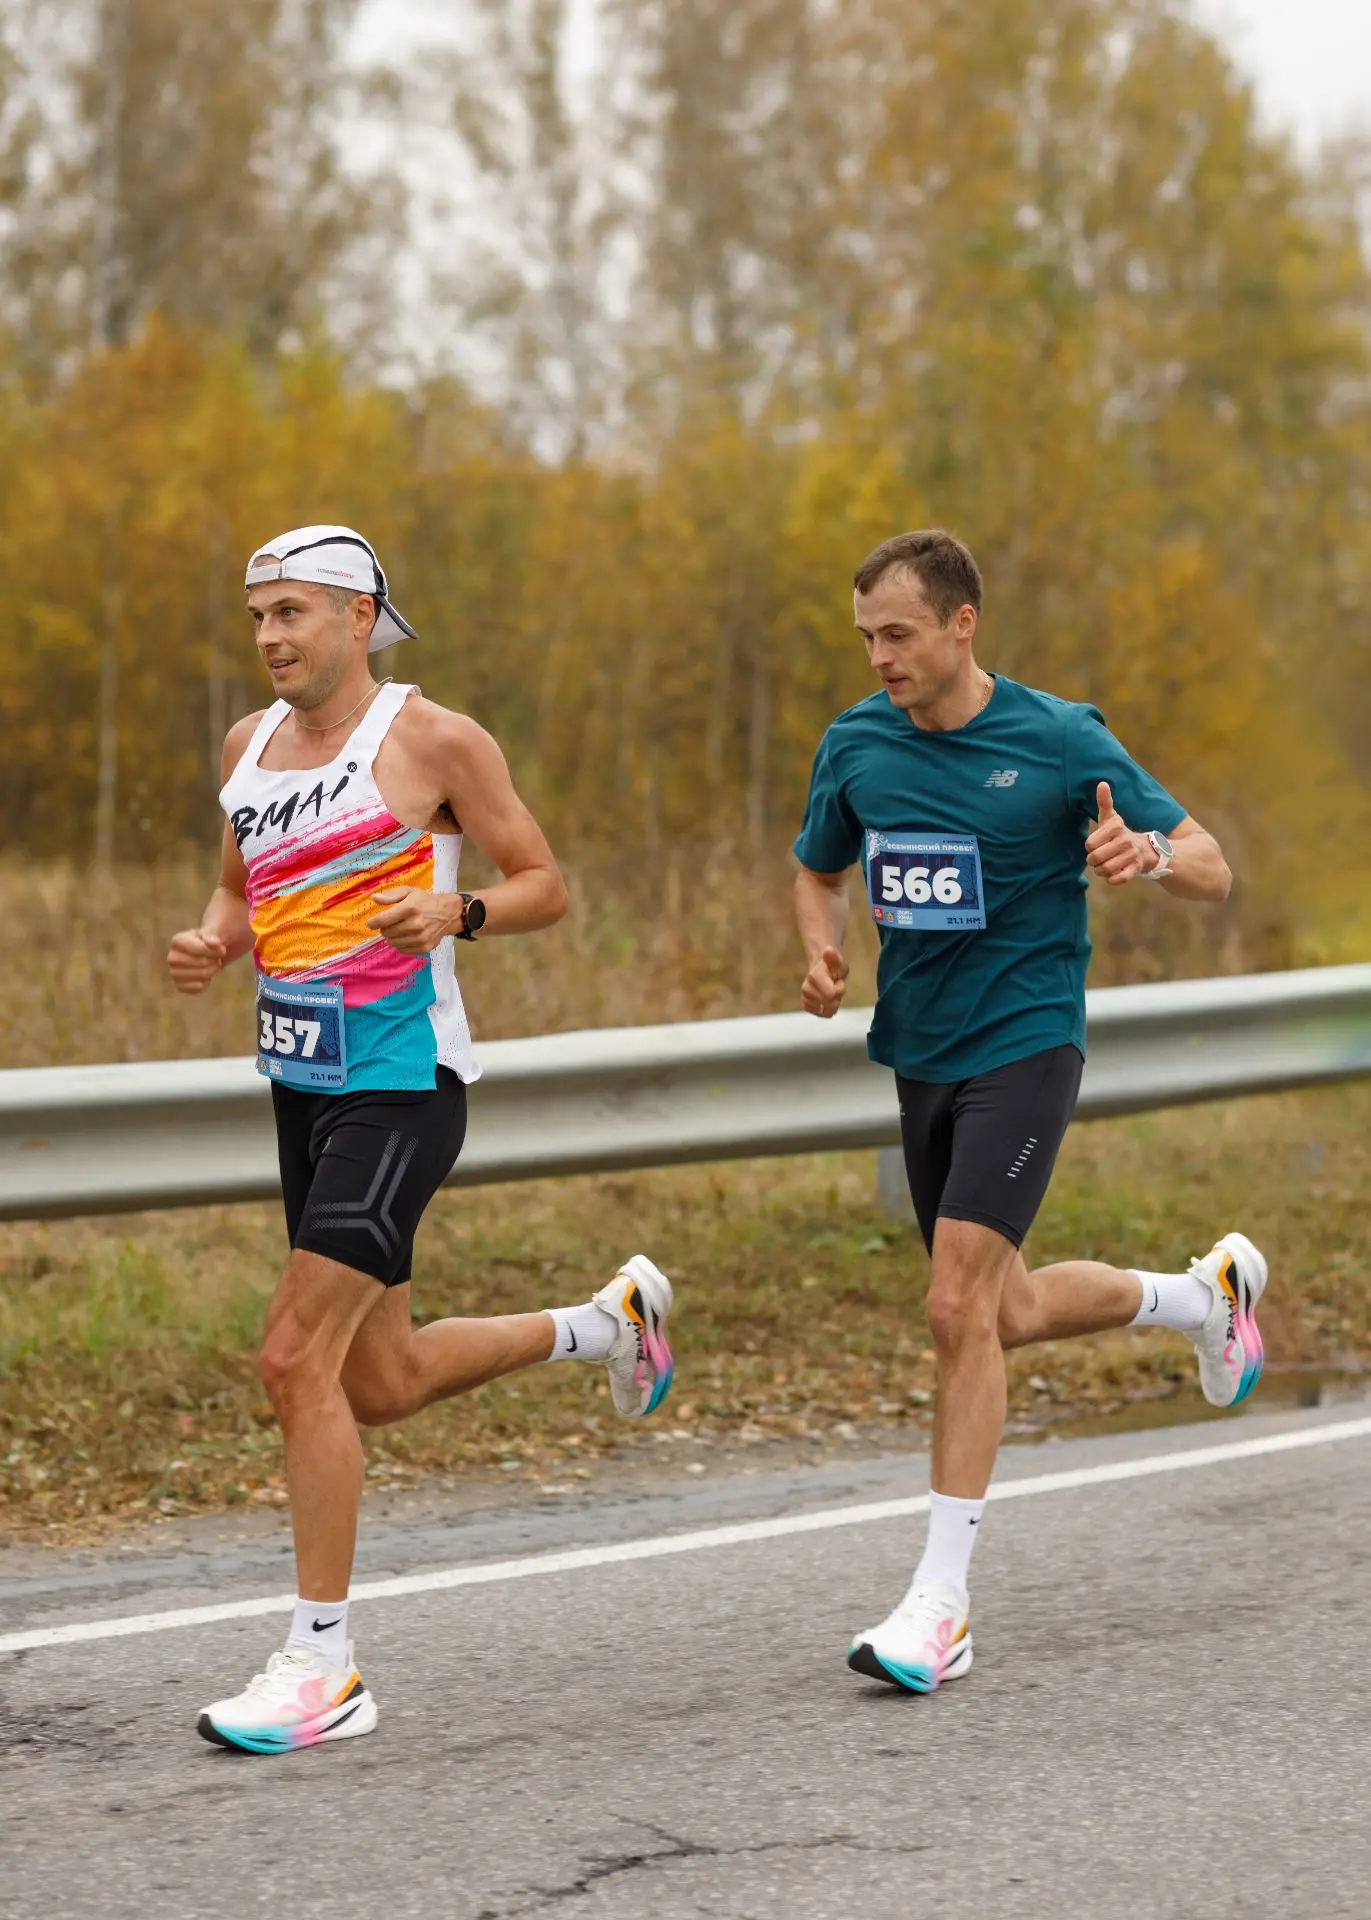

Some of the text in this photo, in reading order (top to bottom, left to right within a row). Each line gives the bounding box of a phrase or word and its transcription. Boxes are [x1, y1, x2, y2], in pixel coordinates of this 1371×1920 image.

[887, 842, 974, 852] ЕСЕНИНСКИЙ ПРОБЕГ
[882, 865, 962, 904] 566
[304, 996, 338, 1004] ПРОБЕГ
[260, 1010, 321, 1057] 357
